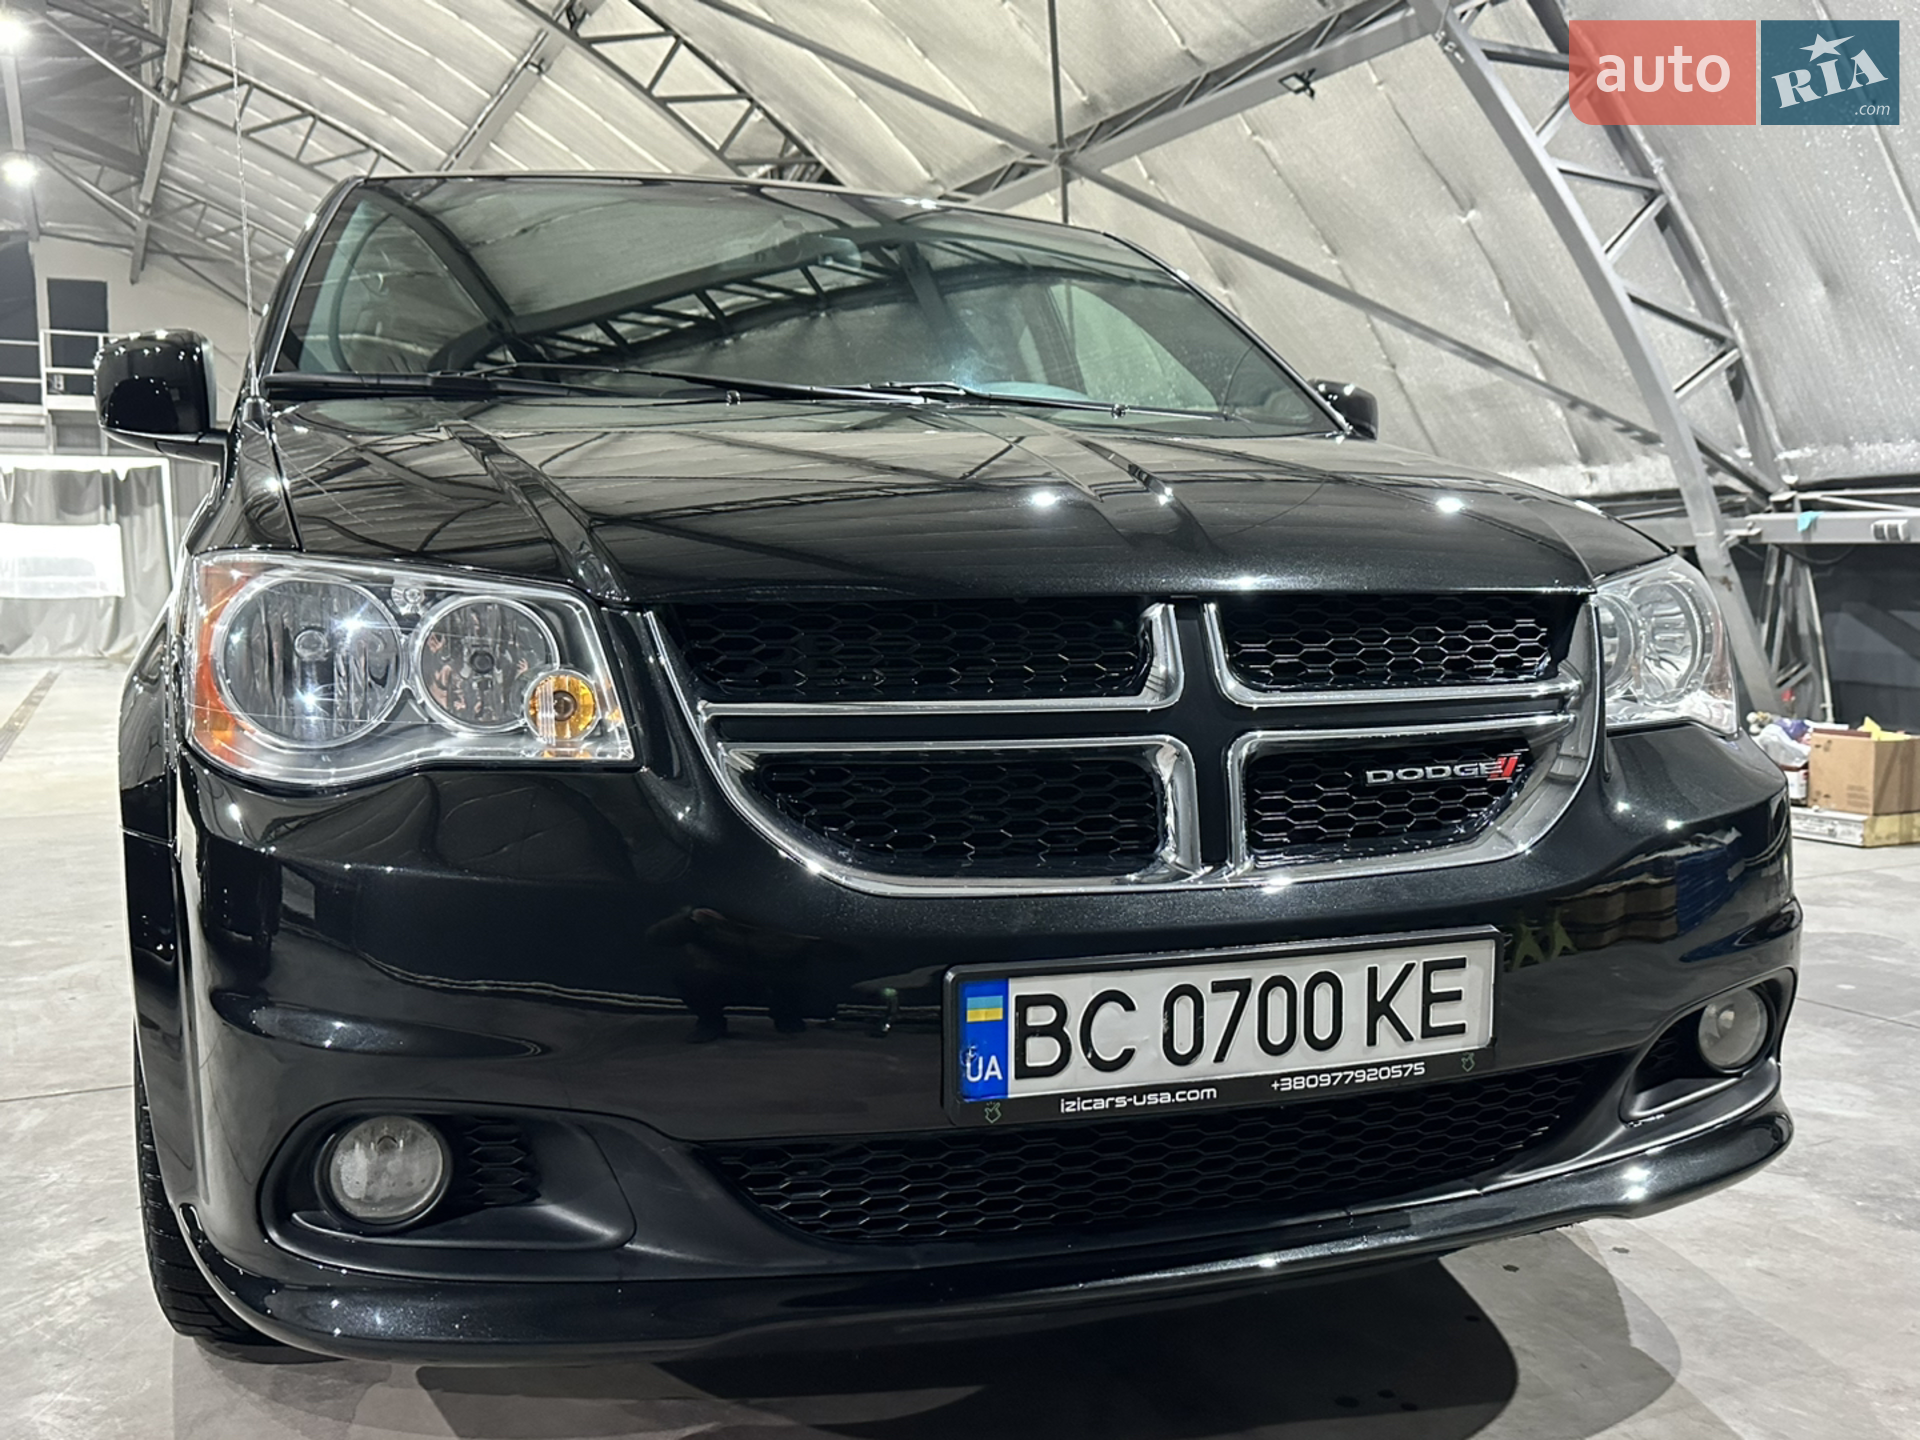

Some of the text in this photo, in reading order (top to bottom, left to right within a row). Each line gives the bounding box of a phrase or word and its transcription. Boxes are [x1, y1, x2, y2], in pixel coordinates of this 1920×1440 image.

[1366, 761, 1503, 783] DODGE
[1013, 957, 1467, 1080] BC 0700 KE
[965, 1054, 1003, 1082] UA
[1060, 1062, 1426, 1113] izicars-usa.com +380977920575
